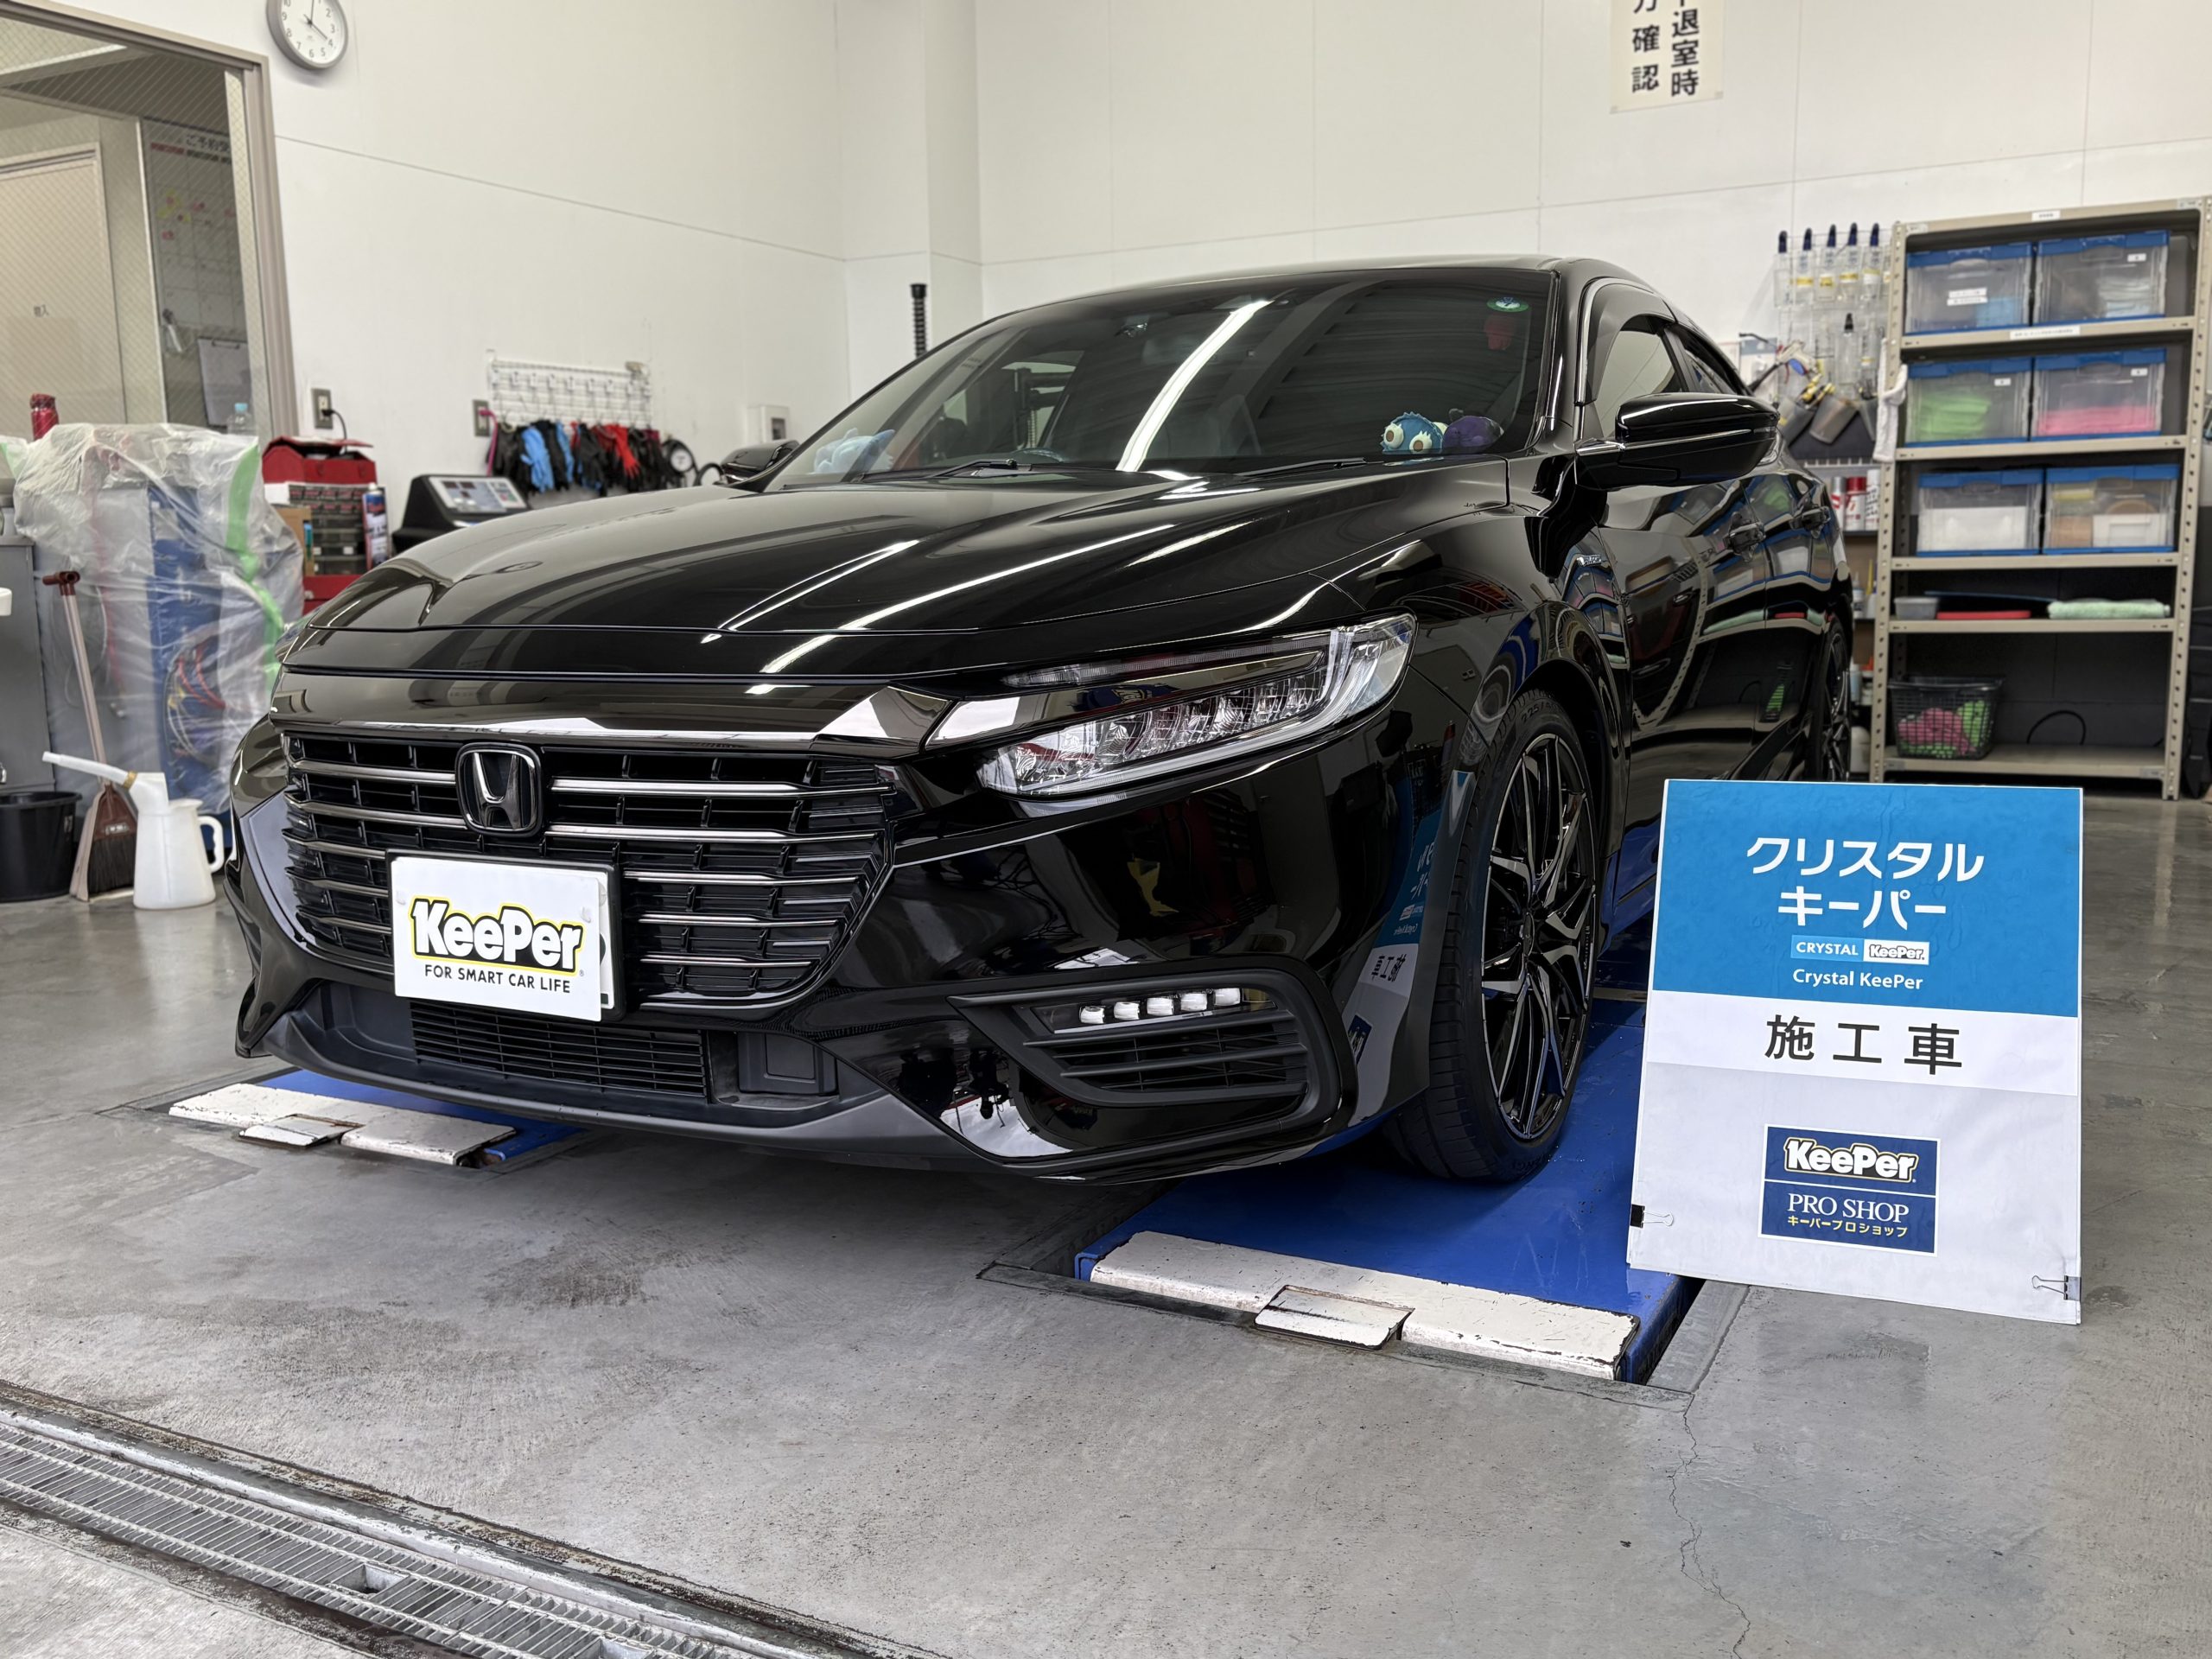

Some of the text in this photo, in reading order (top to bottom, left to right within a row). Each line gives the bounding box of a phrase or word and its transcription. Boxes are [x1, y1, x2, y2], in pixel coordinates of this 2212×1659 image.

[1671, 0, 1700, 97] 退室時
[1746, 836, 1985, 882] クリスタル
[1777, 886, 1947, 931] キーパー
[410, 896, 585, 976] KeePer
[1796, 941, 1923, 960] CRYSTAL KeePer
[424, 964, 571, 994] FOR SMART CAR LIFE
[1792, 969, 1924, 990] Crystal KeePer
[1764, 1014, 1963, 1076] 施工車
[1783, 1136, 1920, 1183] KeePer
[1787, 1192, 1910, 1224] PRO SHOP
